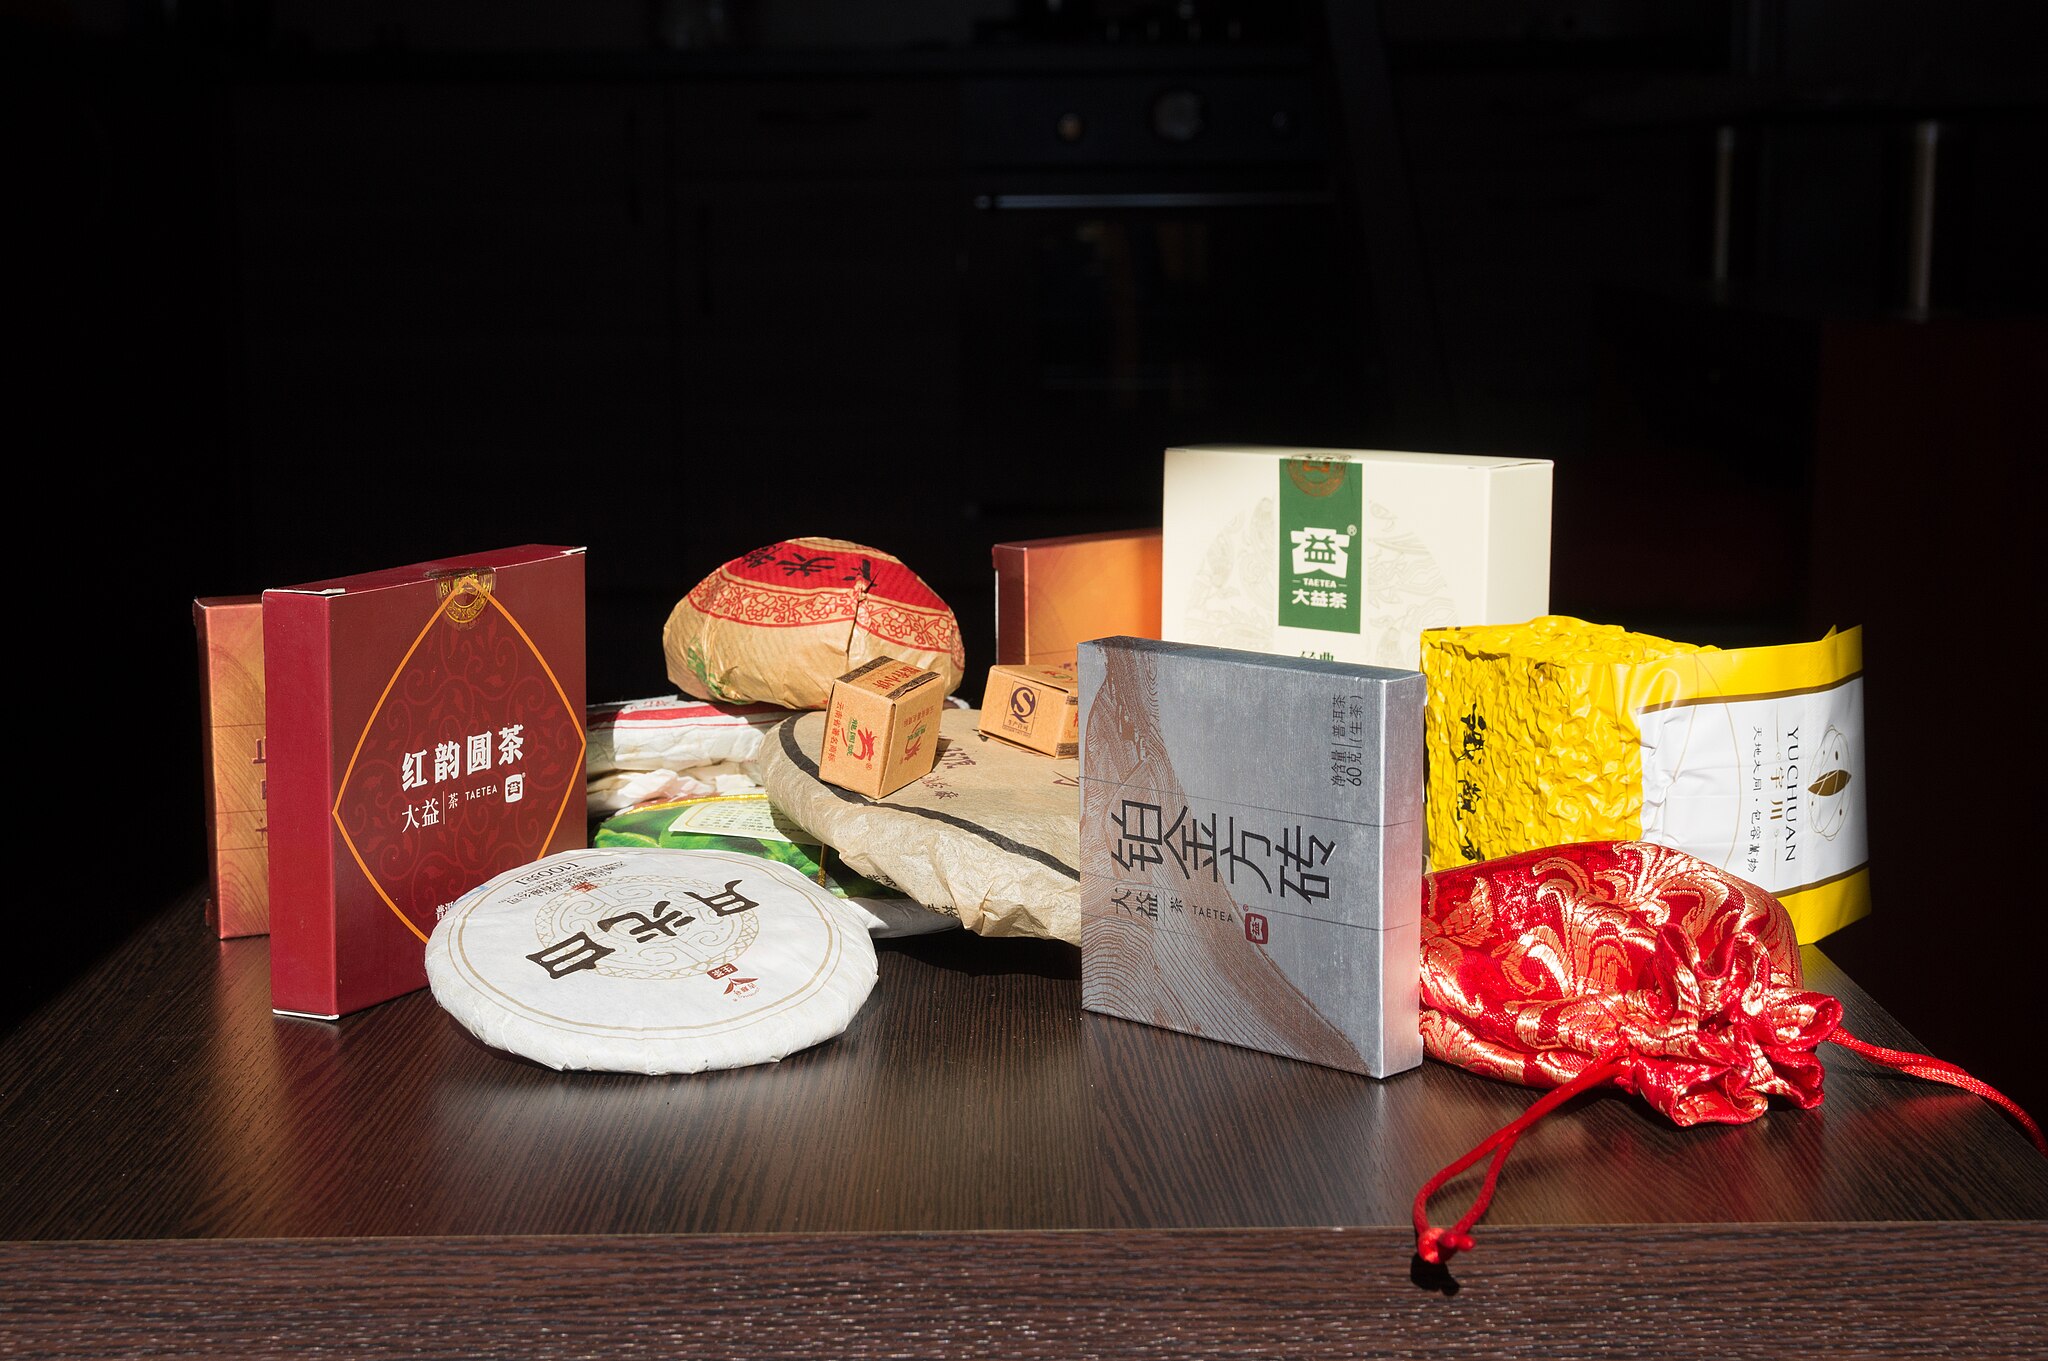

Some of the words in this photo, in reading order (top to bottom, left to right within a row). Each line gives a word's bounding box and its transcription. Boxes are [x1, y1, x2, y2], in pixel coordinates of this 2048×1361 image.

[1292, 588, 1347, 609] 大益茶
[1303, 577, 1337, 588] TAETEA
[828, 701, 846, 763] 云南省著名商标
[1332, 693, 1346, 738] 普洱茶
[401, 724, 524, 791] 红韵圆茶
[1331, 750, 1346, 787] 净含量
[1346, 751, 1362, 787] 60克
[401, 797, 440, 833] 大益
[448, 792, 459, 810] 茶
[465, 784, 498, 800] TAETEA
[1770, 767, 1784, 820] 宇川
[1785, 726, 1799, 862] YUCHUAN
[1111, 800, 1336, 904] 铂金方砖
[525, 879, 760, 979] 月光白
[1111, 887, 1158, 921] 大益
[1170, 896, 1183, 913] 茶
[1192, 905, 1234, 923] TAETEA
